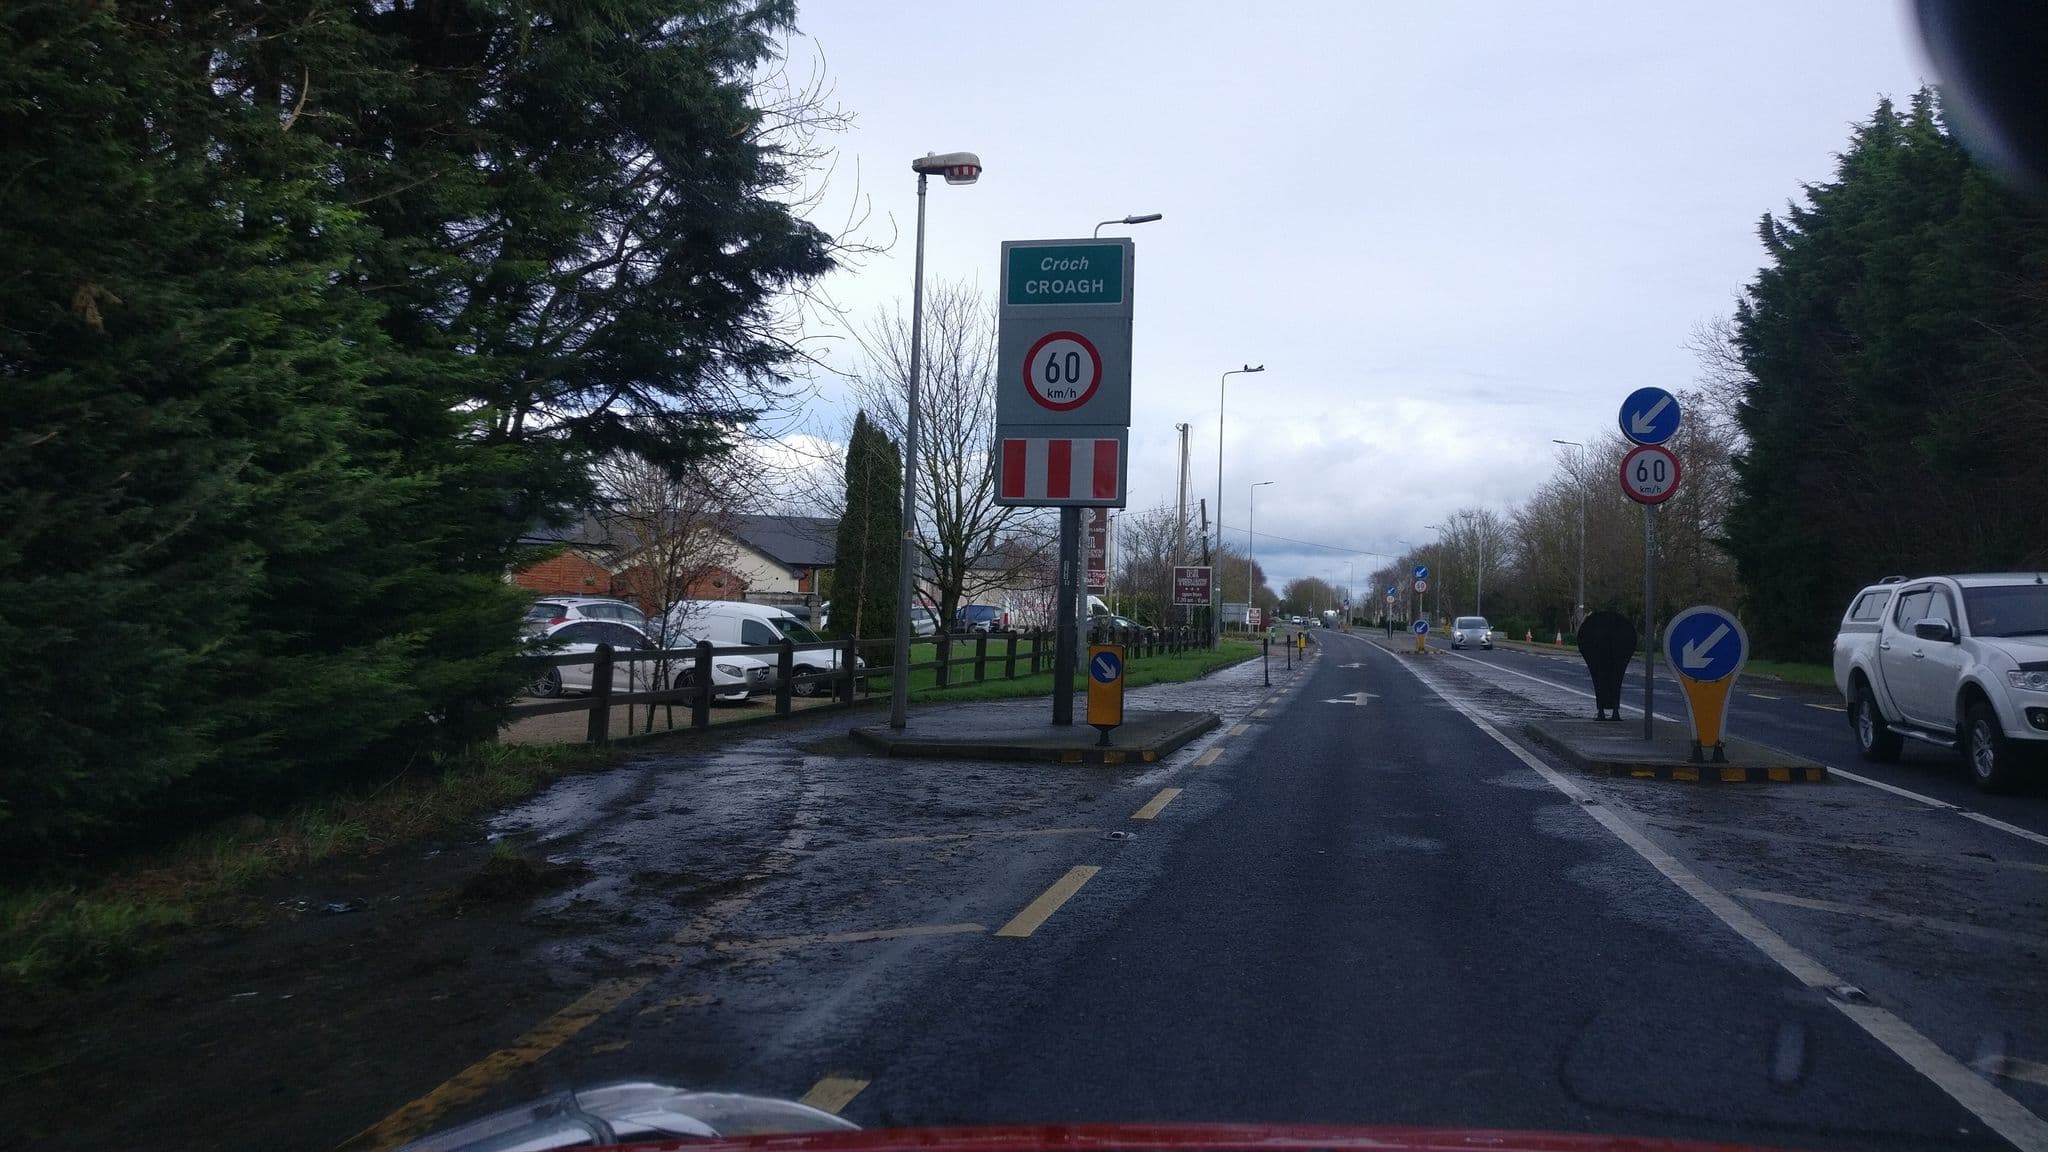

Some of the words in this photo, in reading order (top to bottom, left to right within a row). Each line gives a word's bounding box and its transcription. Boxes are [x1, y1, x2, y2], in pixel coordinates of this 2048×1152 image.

[1040, 256, 1089, 271] Cróch
[1026, 279, 1104, 294] CROAGH
[1045, 352, 1080, 383] 60
[1047, 388, 1077, 399] km/h
[1636, 459, 1665, 482] 60
[1639, 485, 1662, 494] km/h
